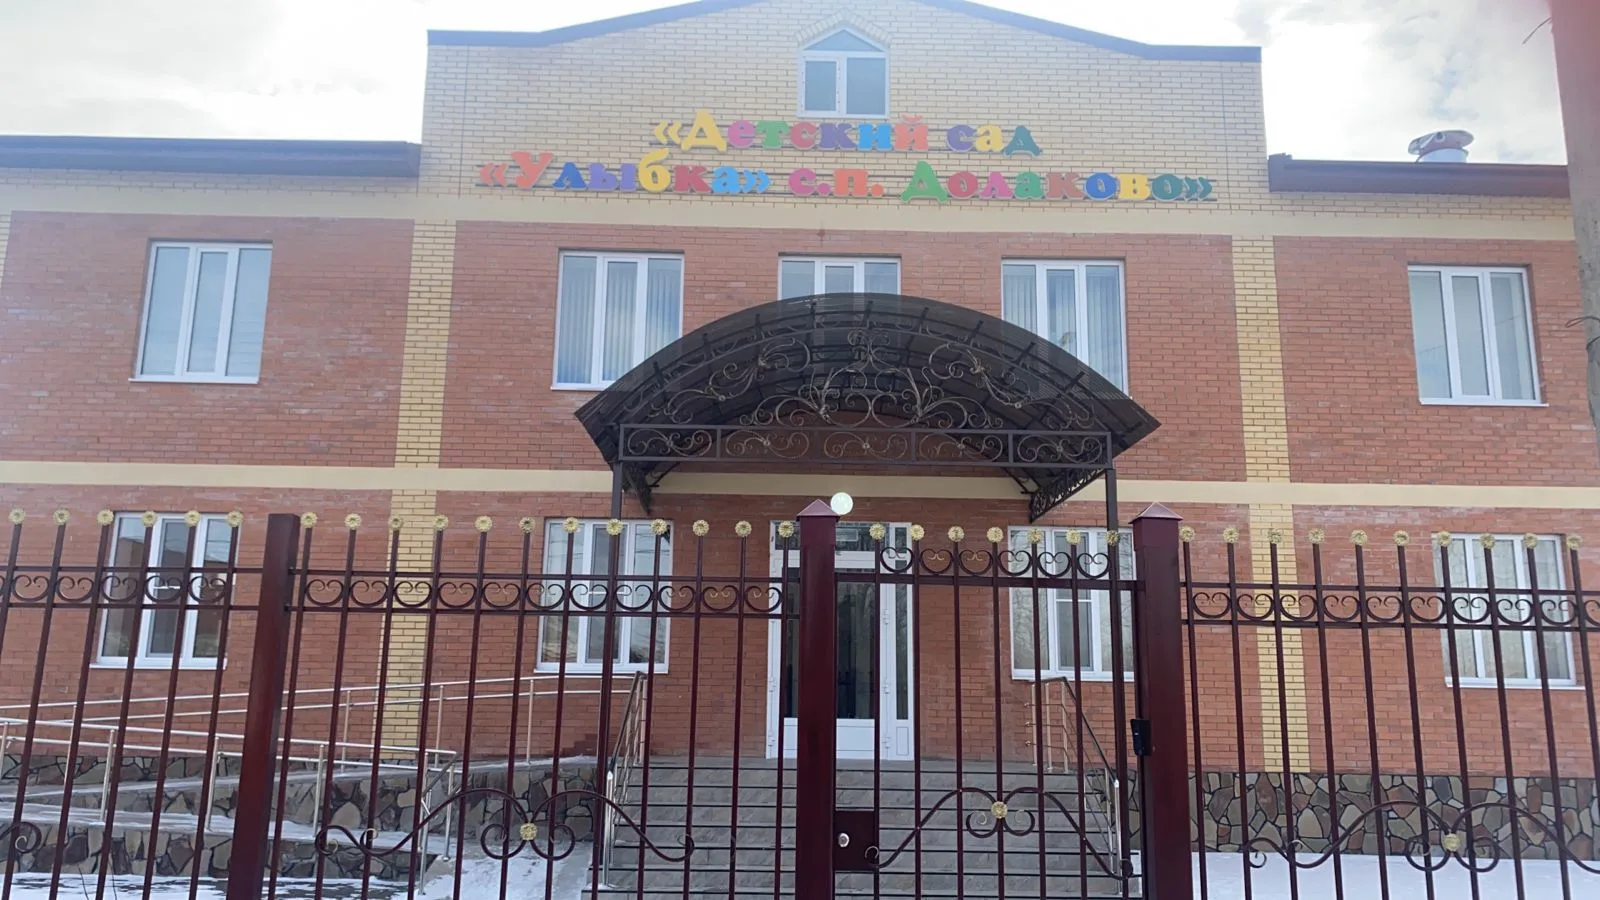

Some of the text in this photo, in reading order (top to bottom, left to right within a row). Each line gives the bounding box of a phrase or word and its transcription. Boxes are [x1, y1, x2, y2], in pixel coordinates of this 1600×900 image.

[654, 109, 1043, 158] «Детский сад
[479, 148, 1213, 203] «Улыбка» с.п. Долаково»
